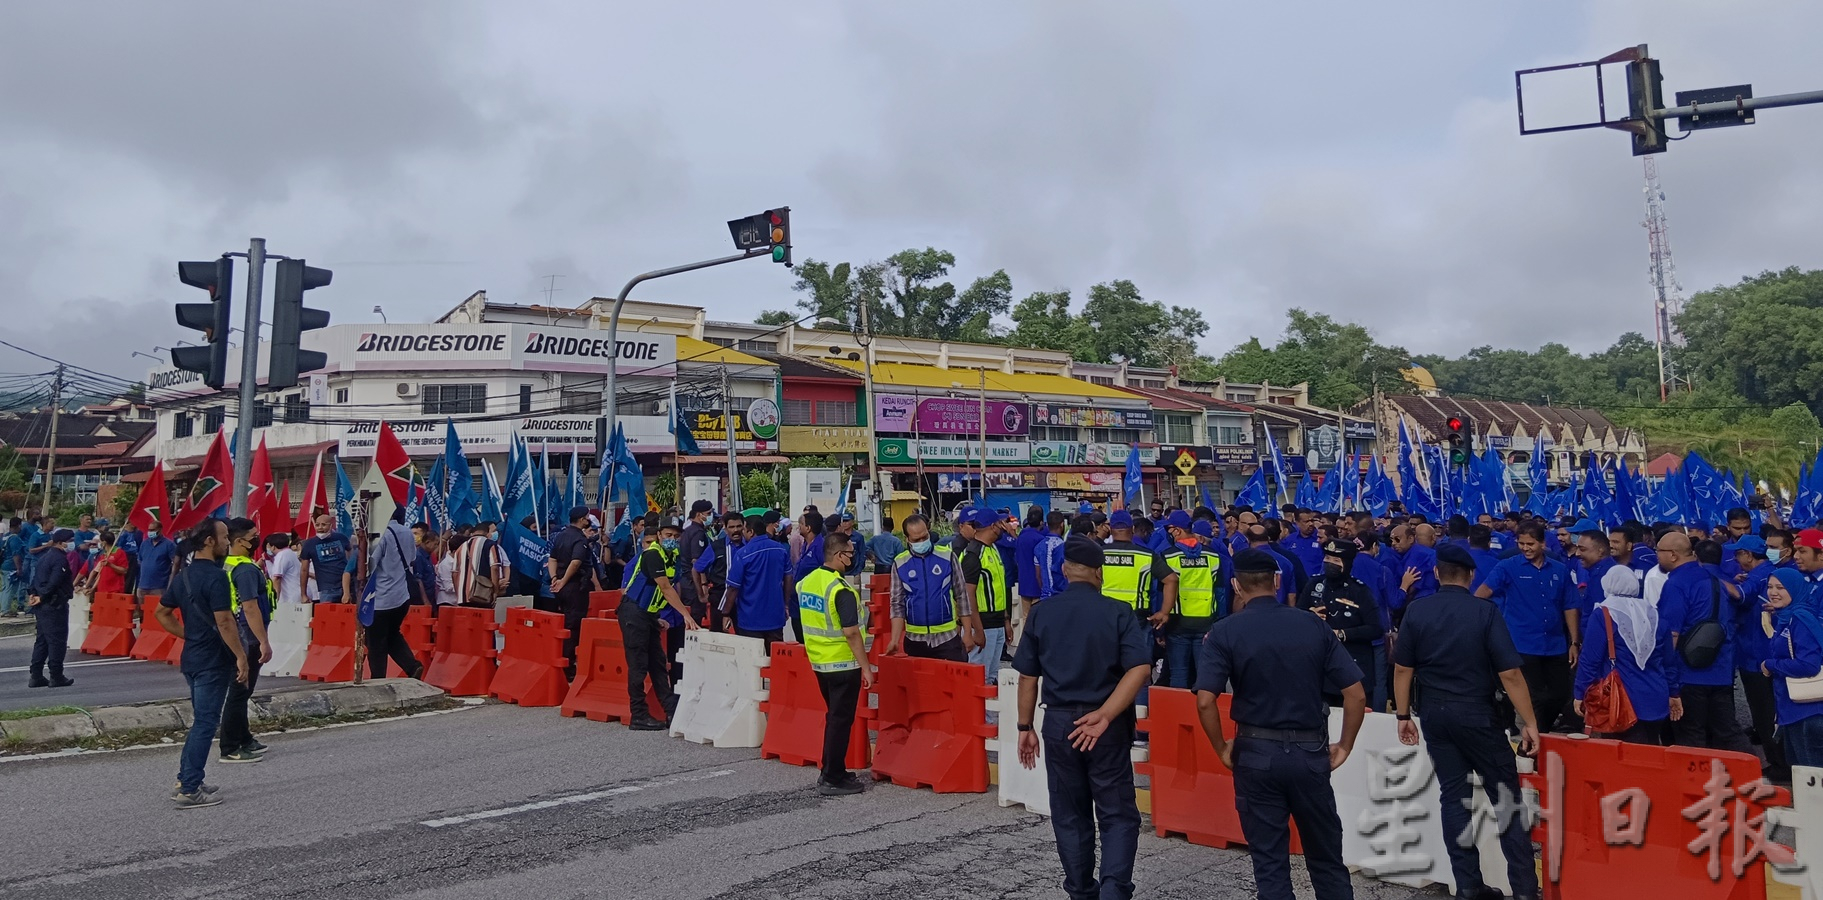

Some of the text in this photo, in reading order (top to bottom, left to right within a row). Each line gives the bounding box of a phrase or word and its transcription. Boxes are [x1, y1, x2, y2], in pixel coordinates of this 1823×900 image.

[357, 333, 506, 352] BRIDGESTONE
[522, 418, 593, 432] BRIDGESTONE
[919, 446, 937, 455] SWEE
[941, 447, 952, 456] HIN
[992, 448, 1017, 457] MARKET
[1104, 555, 1133, 565] SKUAD SABIL
[1195, 557, 1207, 566] SABIL
[776, 648, 792, 657] JKR
